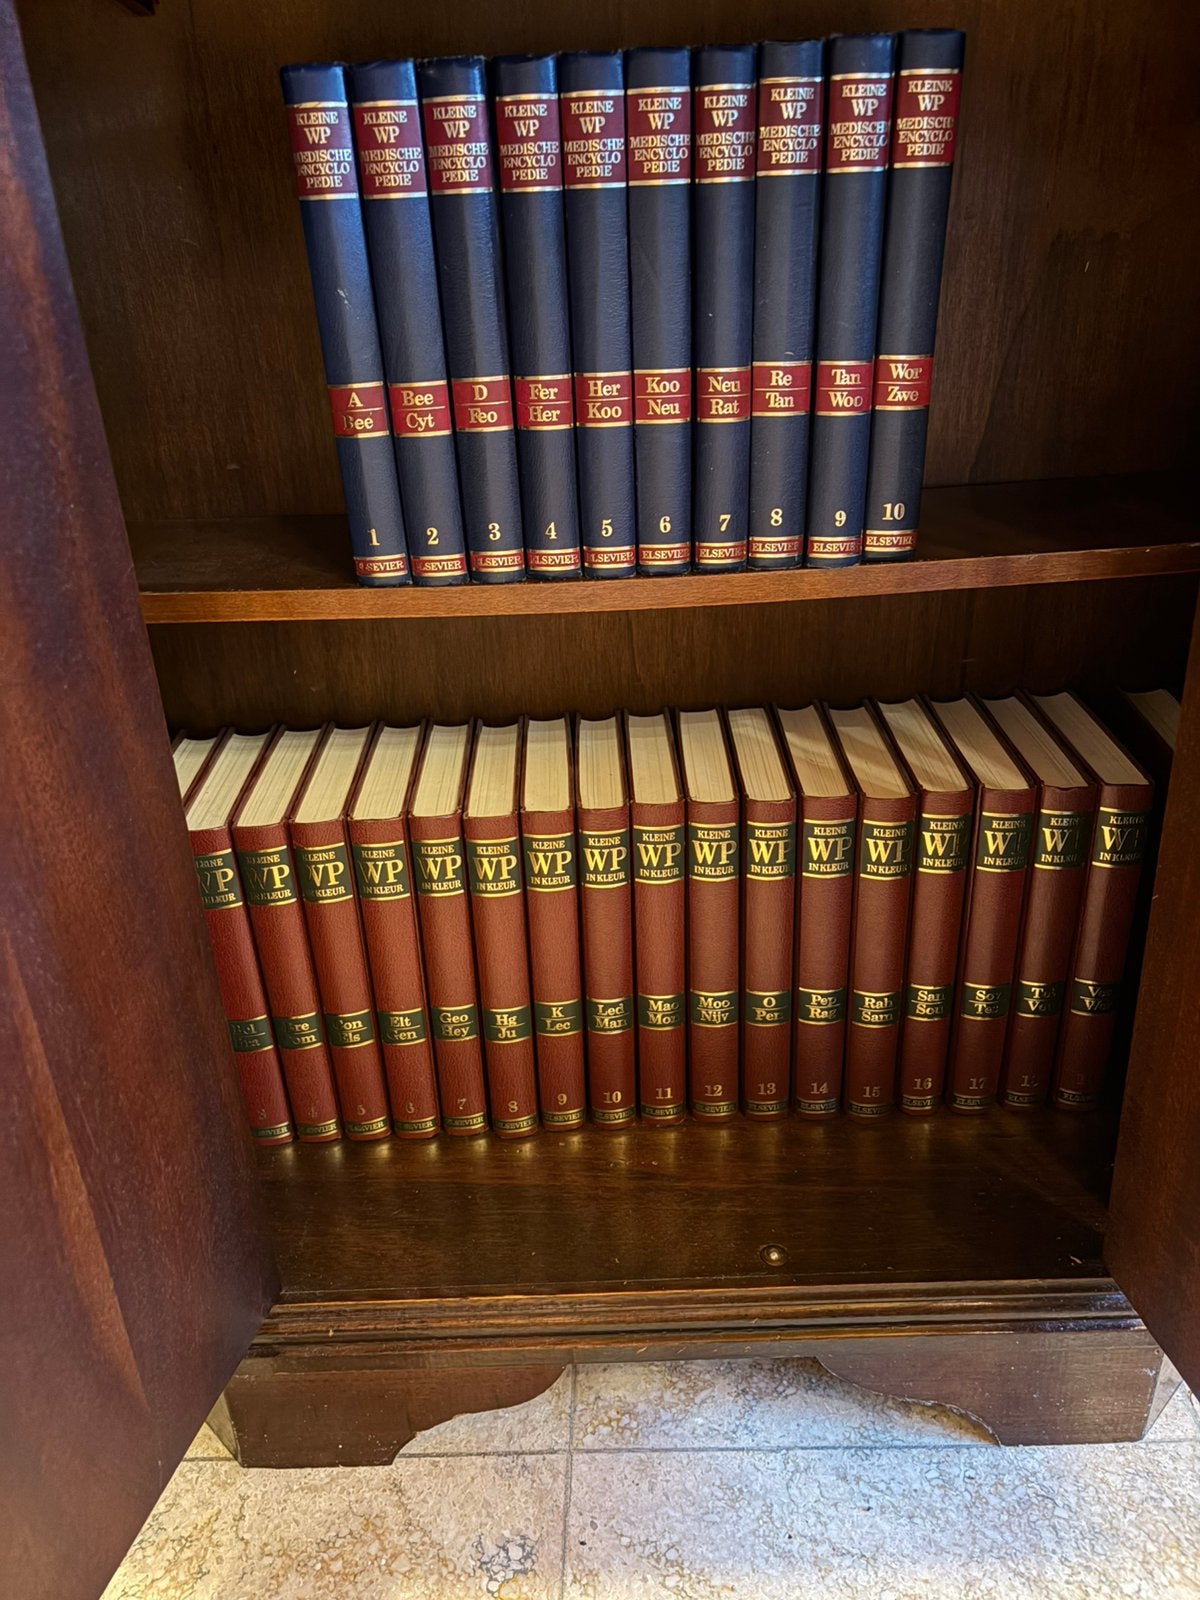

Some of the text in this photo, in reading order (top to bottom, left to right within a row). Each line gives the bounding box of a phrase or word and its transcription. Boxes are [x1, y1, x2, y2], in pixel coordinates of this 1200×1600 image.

[842, 84, 886, 97] KLEINE
[908, 80, 952, 93] KLEINE
[771, 88, 814, 101] KLEINE
[571, 100, 614, 115] KLEINE
[638, 97, 681, 112] KLEINE
[704, 95, 747, 109] KLEINE
[851, 99, 878, 116] WP
[918, 95, 944, 111] WP
[433, 105, 476, 120] KLEINE
[504, 104, 547, 118] KLEINE
[780, 102, 807, 119] WP
[296, 112, 339, 125] KLEINE
[363, 111, 407, 125] KLEINE
[648, 112, 675, 130] WP
[712, 110, 738, 127] WP
[442, 121, 470, 138] WP
[514, 119, 540, 137] WP
[579, 116, 605, 134] WP
[760, 124, 820, 139] MEDISCHE
[304, 127, 331, 144] WP
[373, 126, 400, 143] WP
[899, 130, 953, 143] ENCYCLO
[565, 138, 624, 153] MEDISCHE
[630, 134, 690, 149] MEDISCHE
[763, 138, 817, 151] ENCYCLO
[500, 142, 559, 156] MEDISCHE
[635, 147, 688, 161] ENCYCLO
[700, 145, 752, 158] ENCYCLO
[841, 148, 879, 161] PEDIE
[906, 143, 944, 156] PEDIE
[433, 156, 486, 170] ENCYCLO
[504, 155, 556, 168] ENCYCLO
[568, 151, 621, 165] ENCYCLO
[771, 151, 808, 164] PEDIE
[298, 163, 350, 176] ENCYCLO
[365, 161, 419, 175] ENCYCLO
[643, 161, 680, 173] PEDIE
[707, 158, 745, 171] PEDIE
[442, 170, 479, 183] PEDIE
[512, 168, 548, 181] PEDIE
[576, 165, 612, 178] PEDIE
[306, 176, 342, 189] PEDIE
[375, 174, 411, 187] PEDIE
[832, 369, 861, 385] Tan
[889, 363, 922, 379] Wor
[708, 376, 741, 393] Neu
[770, 370, 792, 386] Re
[588, 380, 620, 397] Her
[646, 377, 680, 393] Koo
[401, 391, 434, 406] Bee
[472, 384, 488, 400] D
[529, 384, 558, 400] Fer
[887, 386, 918, 402] Zwe
[348, 392, 363, 407] A
[766, 392, 794, 408] Tan
[828, 392, 863, 407] Woo
[587, 402, 622, 418] Koo
[648, 399, 680, 415] Neu
[710, 399, 739, 415] Rat
[469, 407, 498, 424] Feo
[529, 406, 560, 422] Her
[344, 415, 374, 430] Bee
[406, 412, 435, 431] Cyt
[771, 508, 783, 526] 8
[882, 503, 905, 521] 10
[659, 516, 671, 533] 6
[719, 514, 732, 531] 7
[835, 511, 846, 527] 9
[488, 522, 501, 540] 3
[545, 522, 558, 539] 4
[602, 519, 612, 537] 5
[368, 528, 380, 546] 1
[426, 527, 439, 545] 2
[643, 549, 689, 559] ELSEVIER
[752, 543, 798, 552] ELSEVIER
[643, 832, 675, 841] KLEINE
[698, 830, 730, 839] KLEINE
[755, 829, 788, 838] KLEINE
[814, 826, 847, 835] KLEINE
[533, 840, 565, 849] KLEINE
[588, 837, 621, 846] KLEINE
[362, 849, 395, 858] KLEINE
[421, 845, 454, 854] KLEINE
[477, 845, 510, 854] KLEINE
[637, 843, 681, 867] WP
[692, 840, 737, 865] WP
[749, 839, 792, 864] WP
[808, 837, 852, 861] WP
[527, 851, 572, 875] WP
[583, 847, 627, 871] WP
[923, 858, 934, 866] IN
[984, 857, 995, 865] IN
[1041, 854, 1052, 862] IN
[1100, 852, 1111, 861] IN
[359, 859, 403, 884] WP
[417, 855, 462, 880] WP
[473, 855, 517, 881] WP
[651, 868, 679, 877] KLEUR
[694, 866, 734, 875] IN KLEUR
[809, 863, 820, 871] IN
[867, 864, 877, 872] IN
[531, 875, 570, 885] IN KLEUR
[586, 872, 625, 882] IN KLEUR
[374, 884, 404, 894] KLEUR
[432, 880, 461, 890] KLEUR
[477, 880, 516, 891] IN KLEUR
[598, 1003, 625, 1015] Led
[699, 997, 730, 1009] Moo
[763, 997, 776, 1008] O
[440, 1013, 469, 1024] Geo
[552, 1007, 564, 1018] K
[700, 1010, 729, 1023] Nijv
[495, 1014, 517, 1026] Hg
[545, 1019, 571, 1030] Lec
[442, 1025, 470, 1037] Hey
[498, 1027, 517, 1038] Ju
[705, 1085, 723, 1096] 12
[758, 1083, 776, 1095] 13
[811, 1082, 829, 1094] 14
[914, 1078, 932, 1090] 16
[603, 1091, 622, 1103] 10
[656, 1088, 673, 1099] 11
[863, 1086, 880, 1098] 15
[457, 1098, 467, 1110] 7
[558, 1094, 567, 1105] 9
[357, 1105, 366, 1115] 5
[508, 1101, 518, 1112] 8
